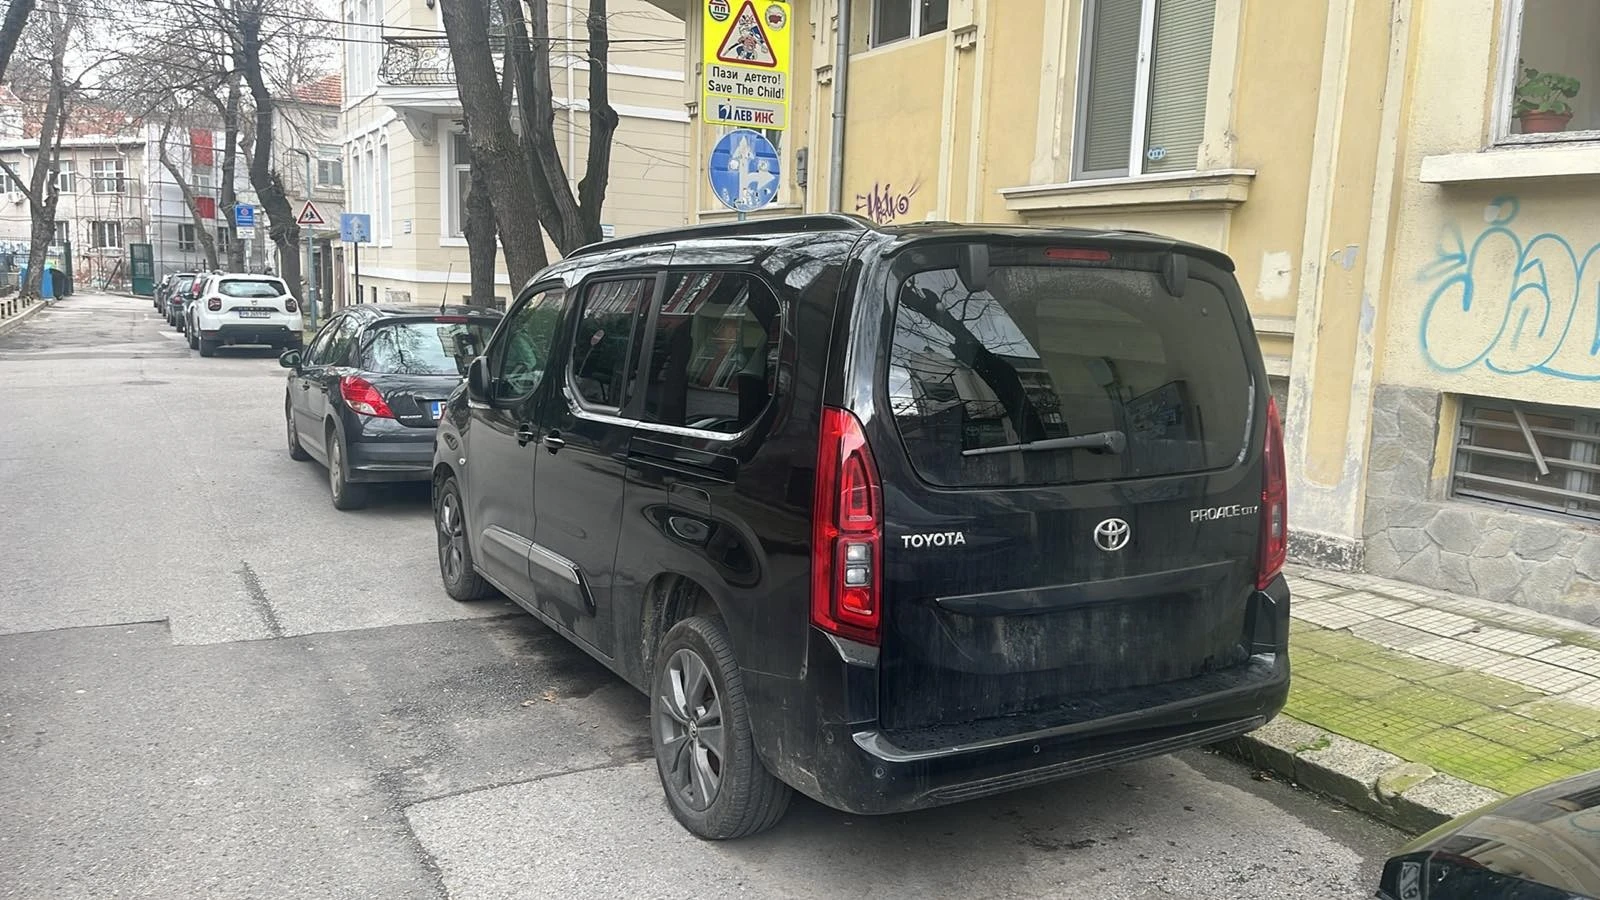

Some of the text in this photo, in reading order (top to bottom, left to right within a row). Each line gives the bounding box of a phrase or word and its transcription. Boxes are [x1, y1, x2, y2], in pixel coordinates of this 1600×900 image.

[712, 66, 781, 85] Пази детето!
[708, 80, 785, 99] Save The Child!
[734, 109, 774, 124] ЛЕВ ИНС
[1190, 504, 1241, 523] PROACE
[901, 531, 967, 549] TOYOTA
